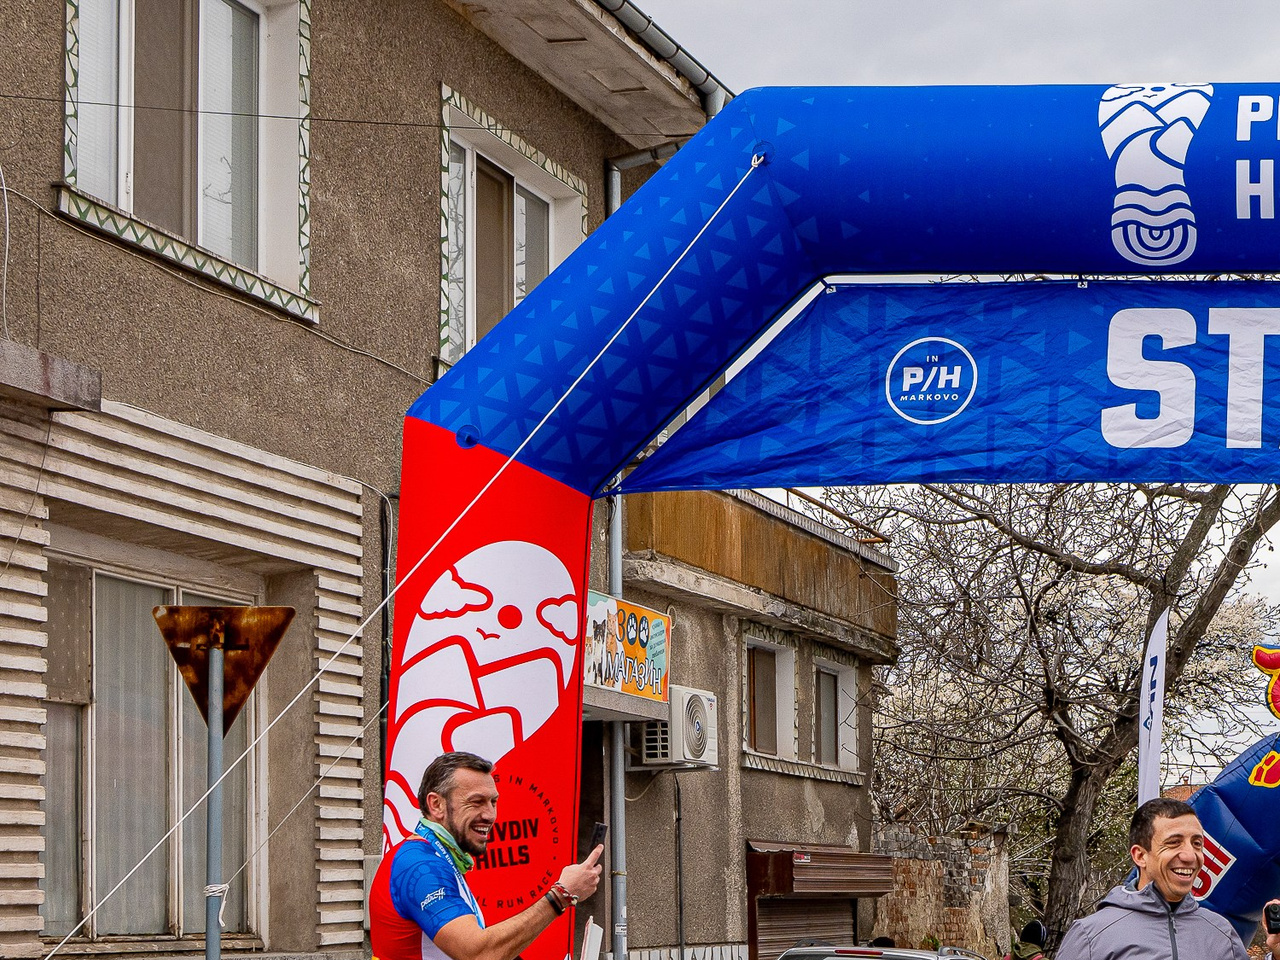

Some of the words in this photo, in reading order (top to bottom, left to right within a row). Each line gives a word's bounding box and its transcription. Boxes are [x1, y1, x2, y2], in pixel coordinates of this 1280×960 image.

[926, 355, 939, 363] IN
[902, 366, 962, 392] P/H
[900, 393, 959, 401] MARKOVO
[605, 650, 662, 695] МАГАЗИН
[475, 845, 530, 871] HILLS
[497, 896, 524, 909] RUN
[530, 869, 553, 899] RACE
